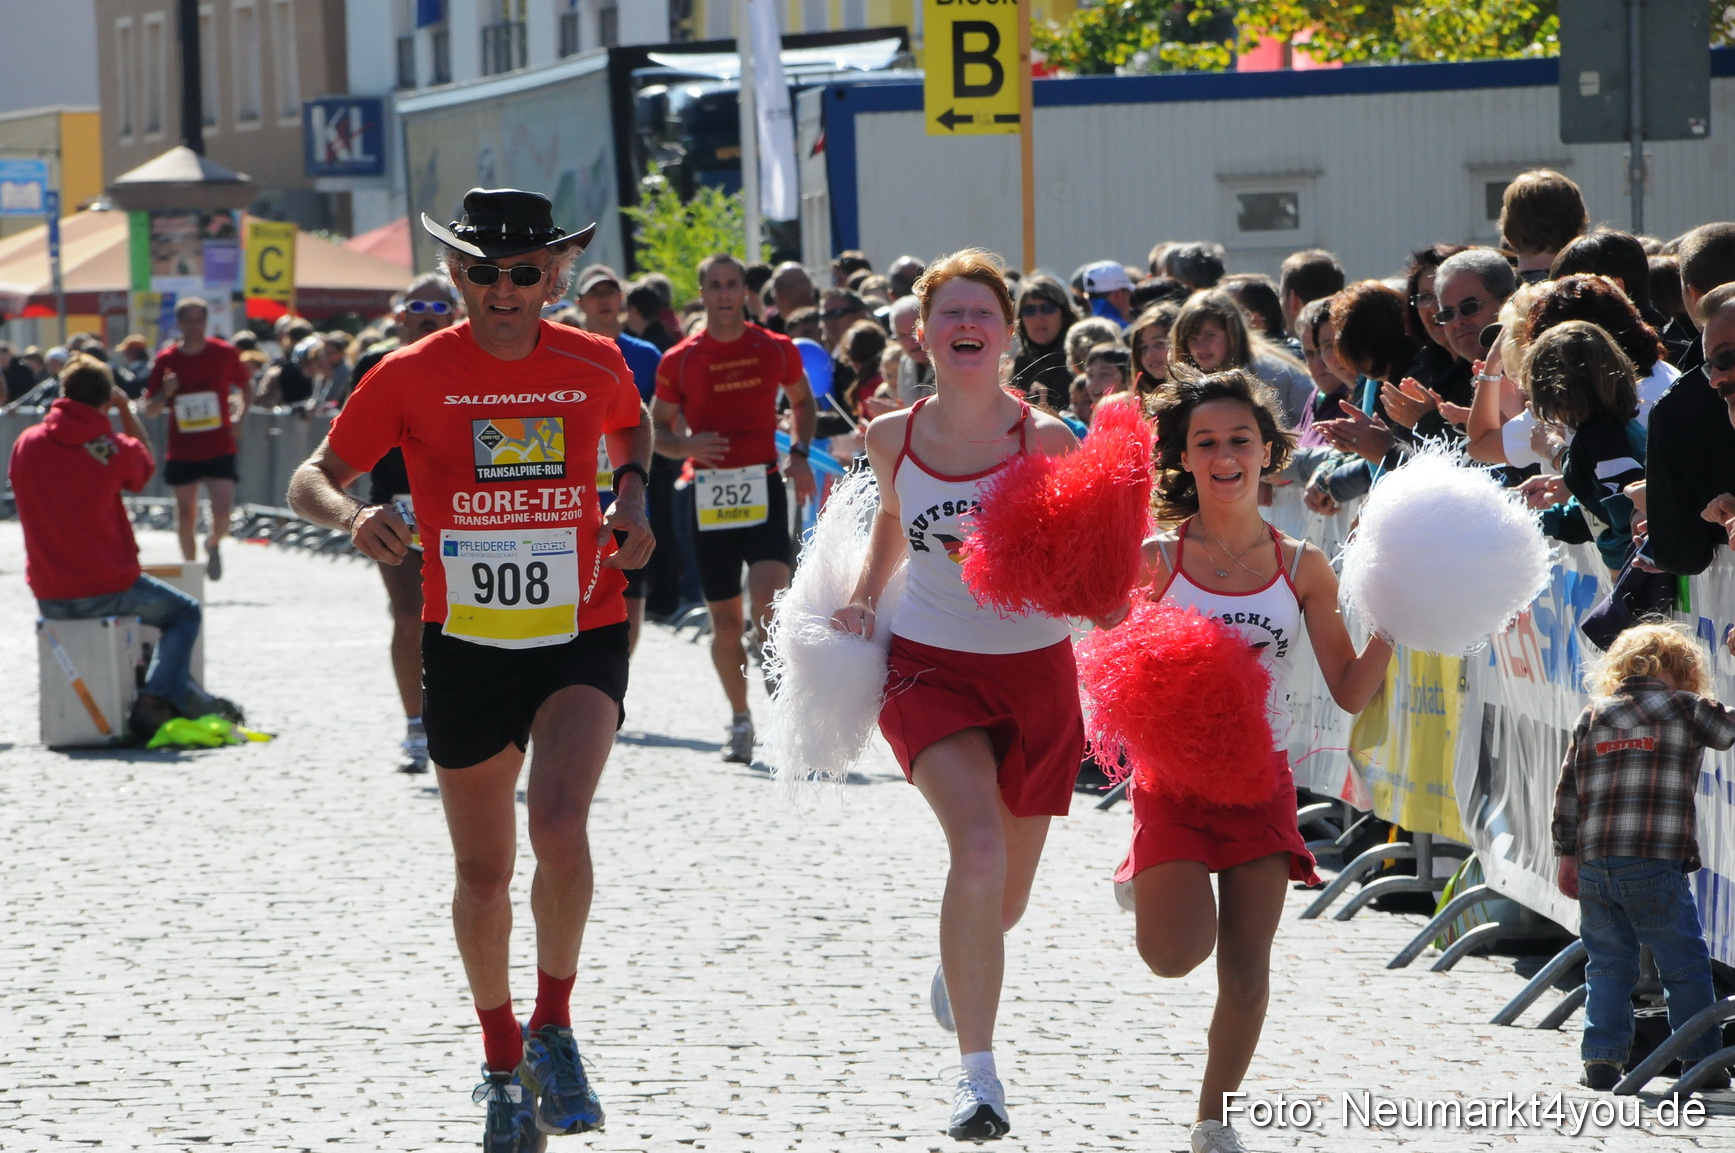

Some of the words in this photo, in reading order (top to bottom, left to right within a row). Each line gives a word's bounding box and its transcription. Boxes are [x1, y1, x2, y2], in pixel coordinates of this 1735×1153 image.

[952, 21, 1004, 97] B
[258, 246, 283, 283] C
[443, 393, 546, 405] SALOMON
[477, 464, 563, 479] TRANSALPINE-RUN
[712, 483, 752, 507] 252
[453, 512, 559, 525] TRANSALPINE-RUN
[561, 509, 582, 521] 2010
[717, 507, 750, 520] Andre
[460, 541, 517, 551] PFLEIDERER
[532, 541, 566, 551] BOCK
[472, 561, 550, 606] 908
